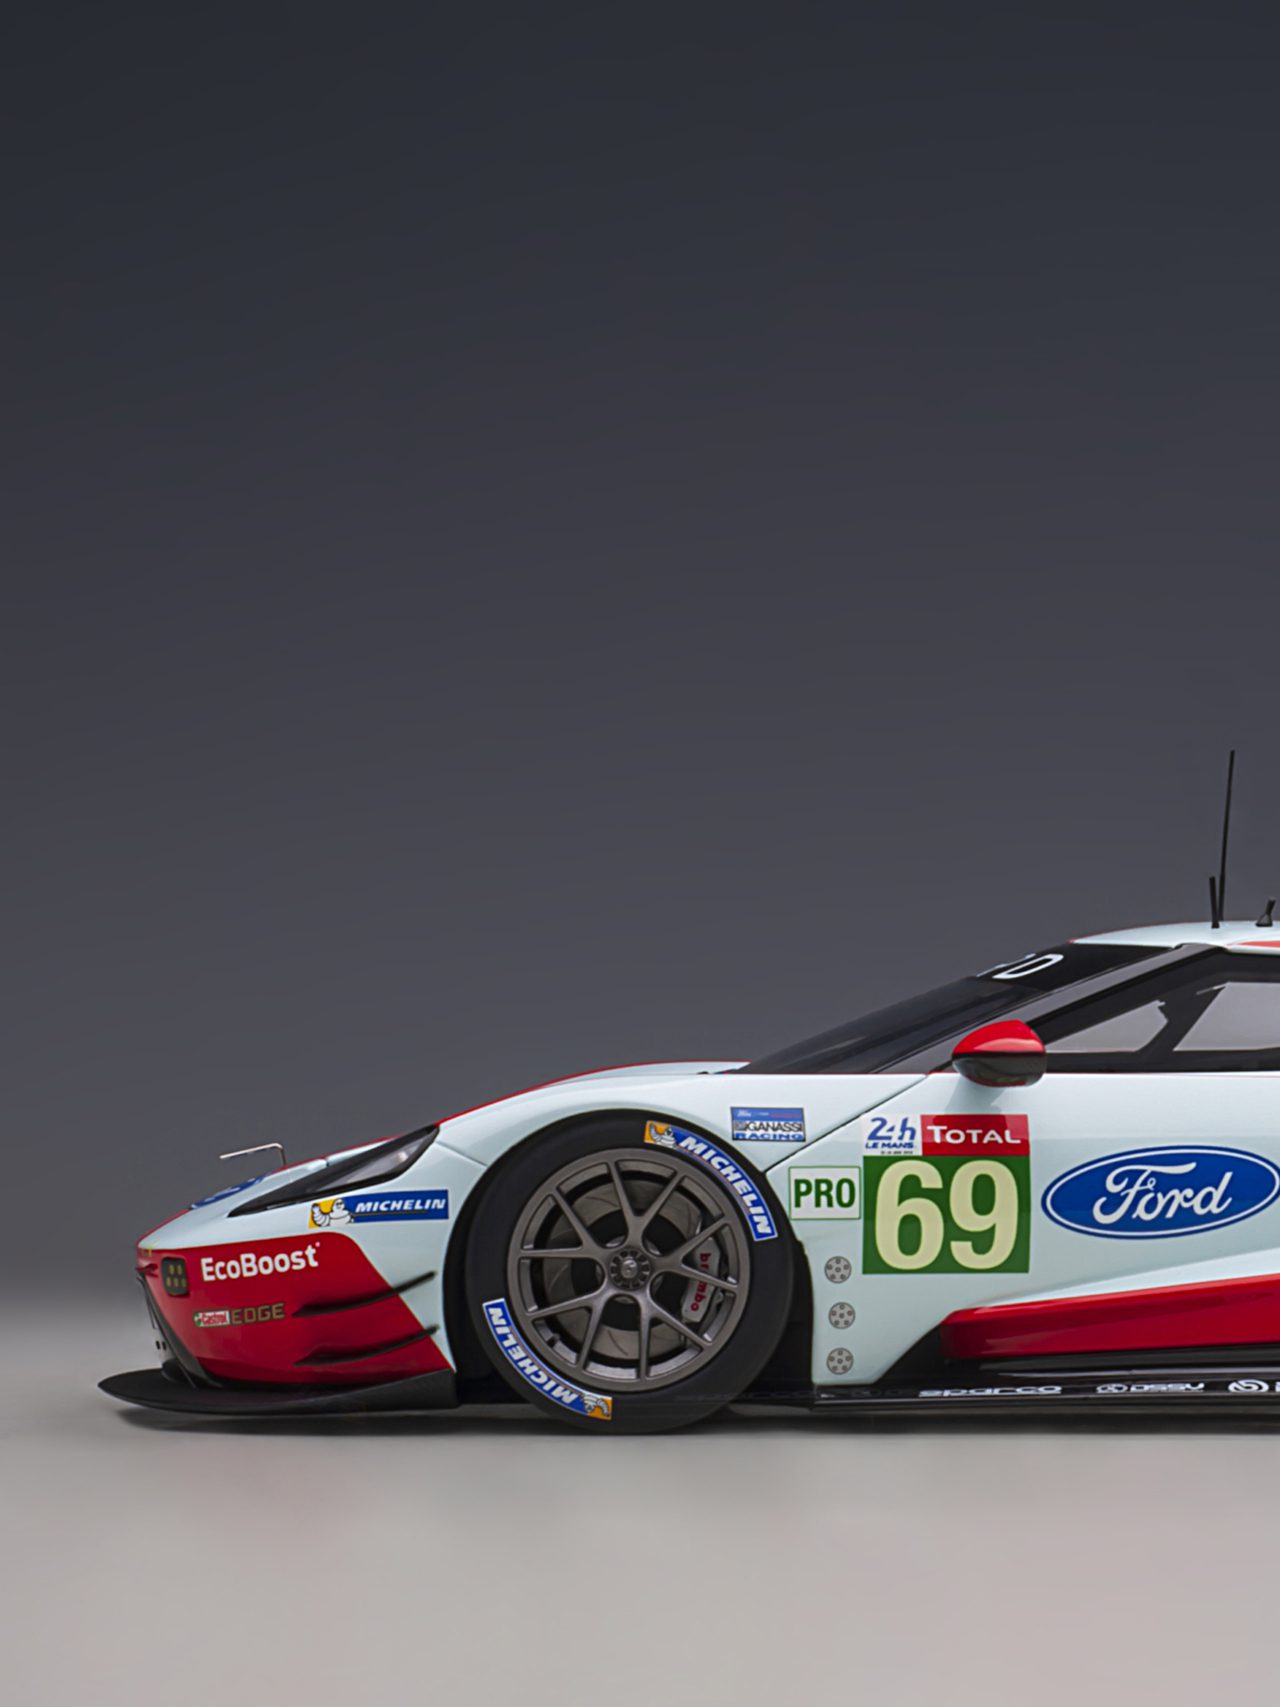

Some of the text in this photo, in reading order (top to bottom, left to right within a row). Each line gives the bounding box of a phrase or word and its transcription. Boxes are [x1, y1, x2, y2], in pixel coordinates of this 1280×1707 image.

[355, 1198, 447, 1213] MICHELIN
[679, 1136, 772, 1239] MICHELIN
[794, 1178, 856, 1209] PRO
[1092, 1162, 1233, 1225] Ford
[875, 1160, 1018, 1270] 69
[200, 1245, 318, 1282] EcoBoost
[231, 1302, 286, 1325] EDGE
[488, 1306, 576, 1404] MICHELIN
